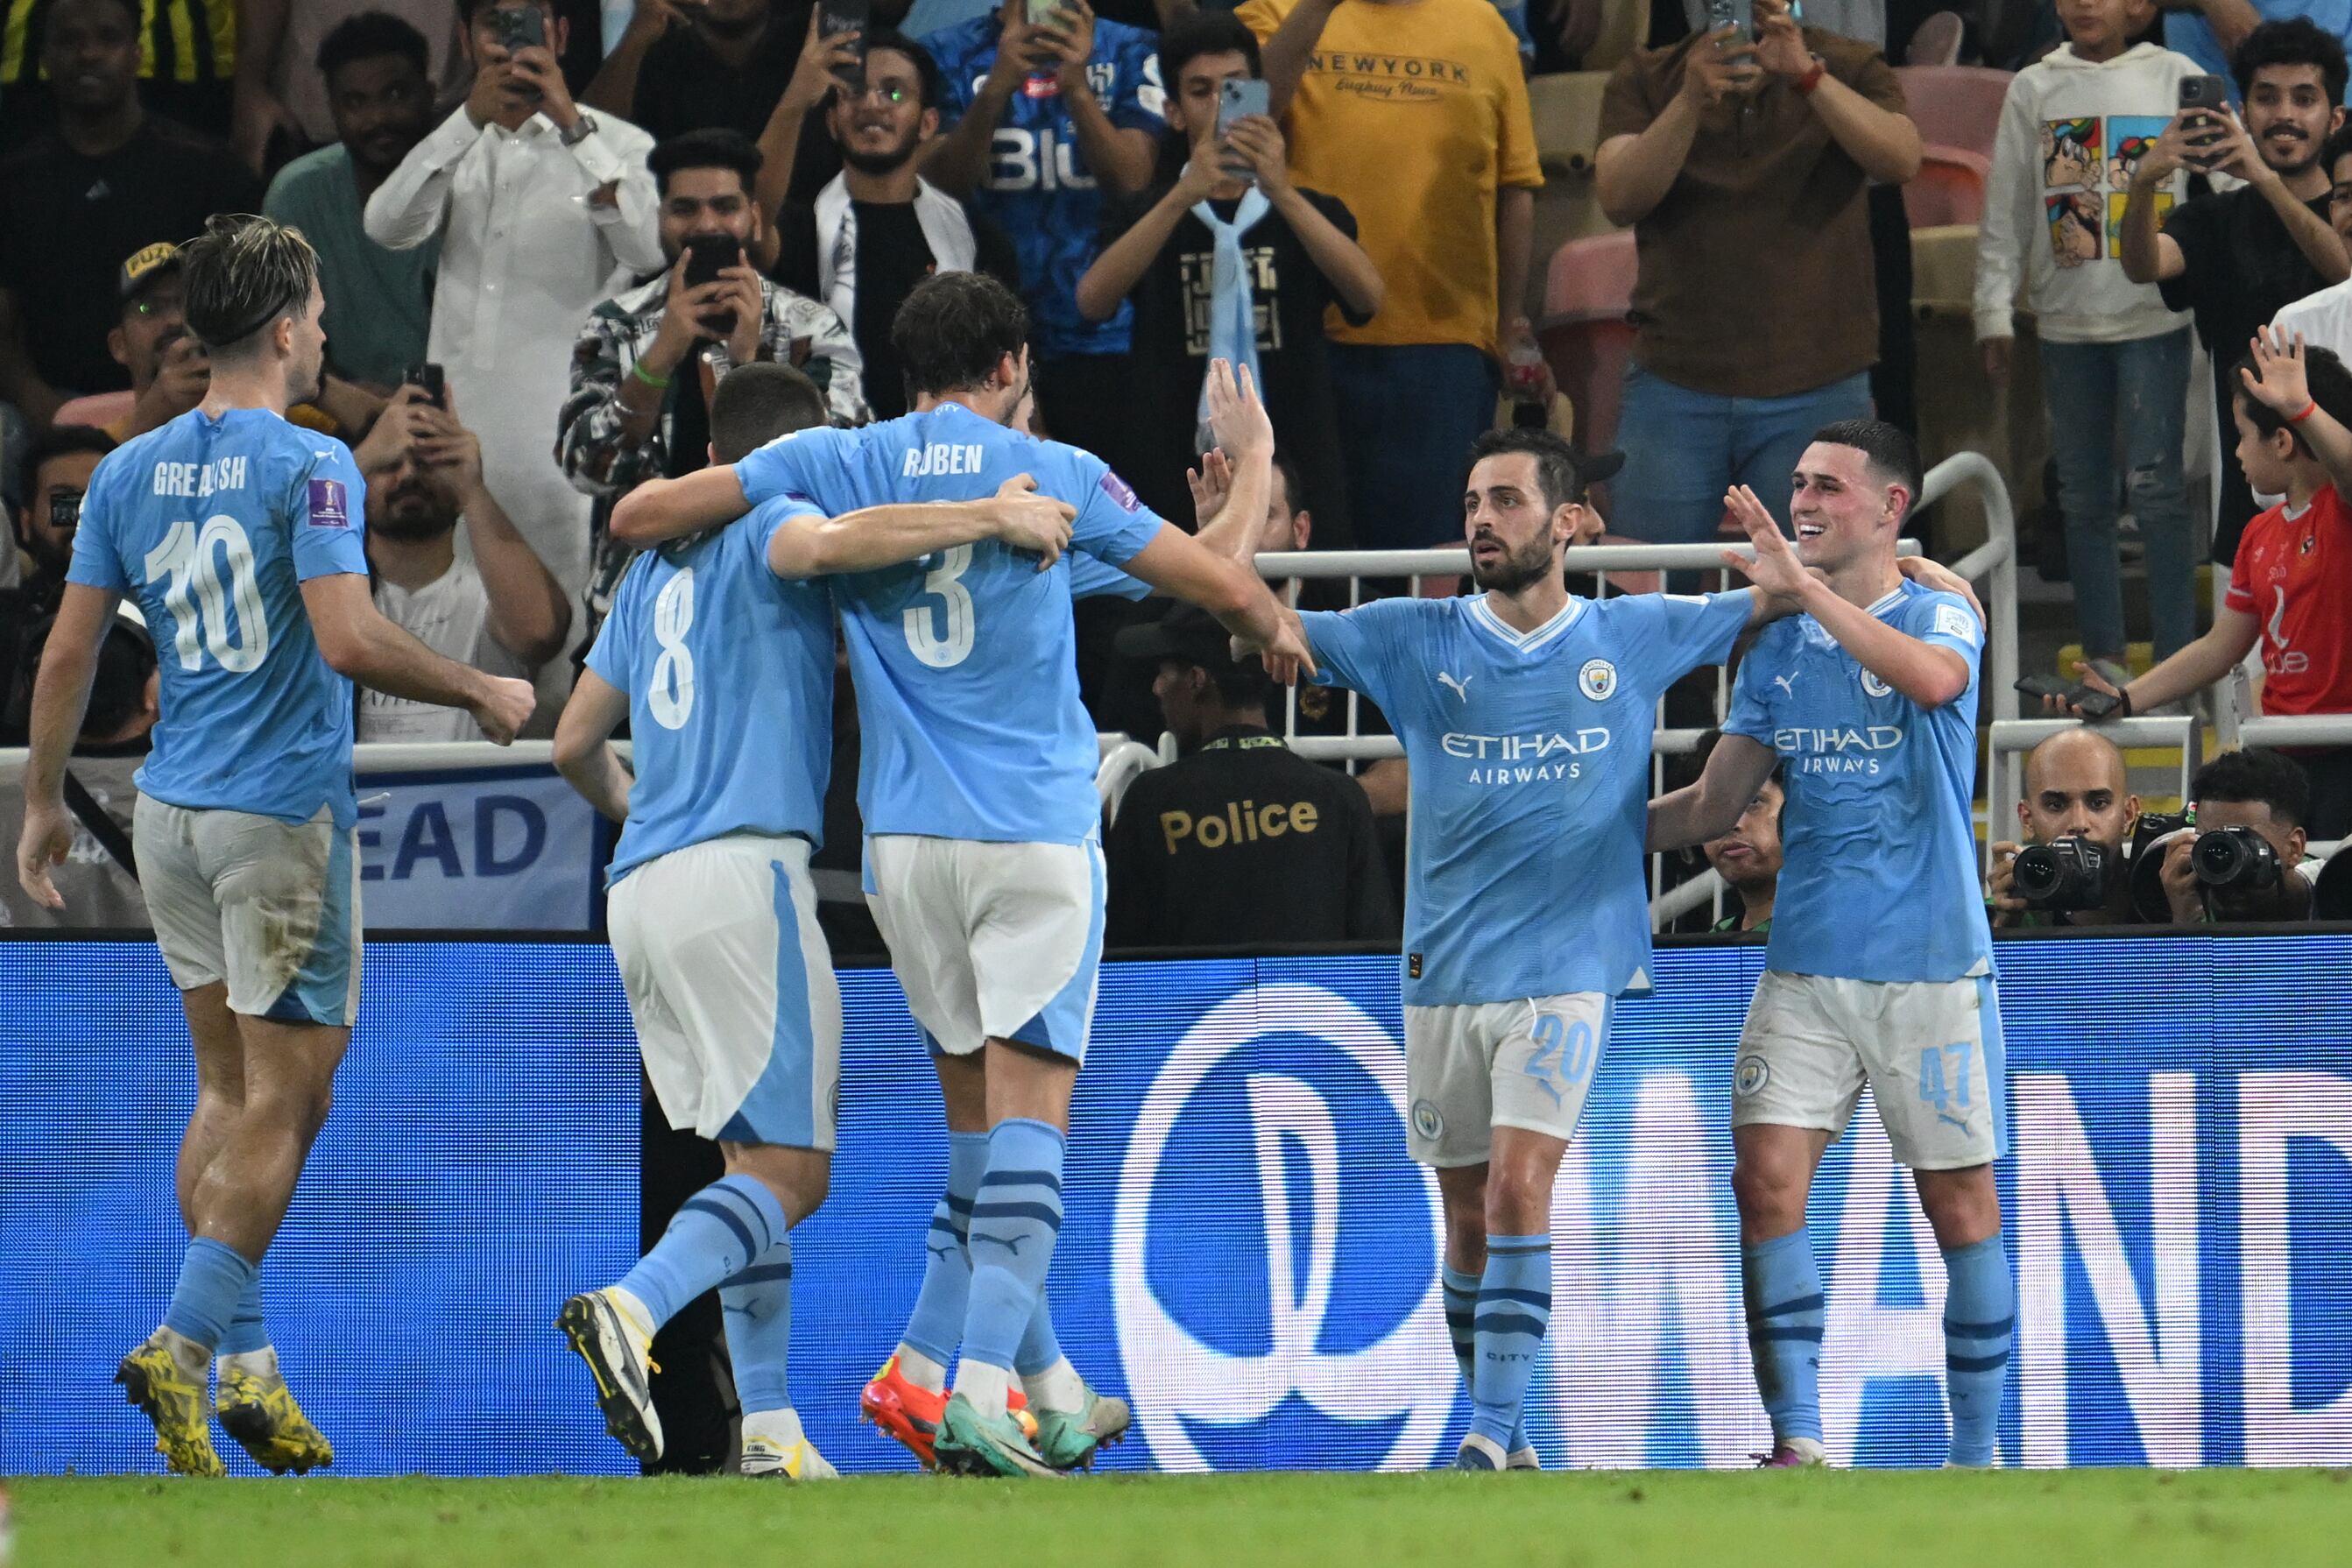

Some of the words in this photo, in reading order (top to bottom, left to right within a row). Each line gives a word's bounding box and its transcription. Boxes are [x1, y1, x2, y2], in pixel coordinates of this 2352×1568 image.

[144, 514, 268, 673] 10
[903, 540, 975, 668] 3
[648, 566, 694, 731] 8
[1442, 727, 1610, 760] ETIHAD
[1774, 725, 1903, 753] ETIHAD
[1803, 757, 1880, 774] IRWAYS
[1468, 763, 1580, 785] AIRWAYS
[1160, 799, 1318, 855] Police
[1524, 1014, 1592, 1084] 20
[1919, 1042, 1972, 1111] 47
[1487, 1352, 1529, 1362] CITY
